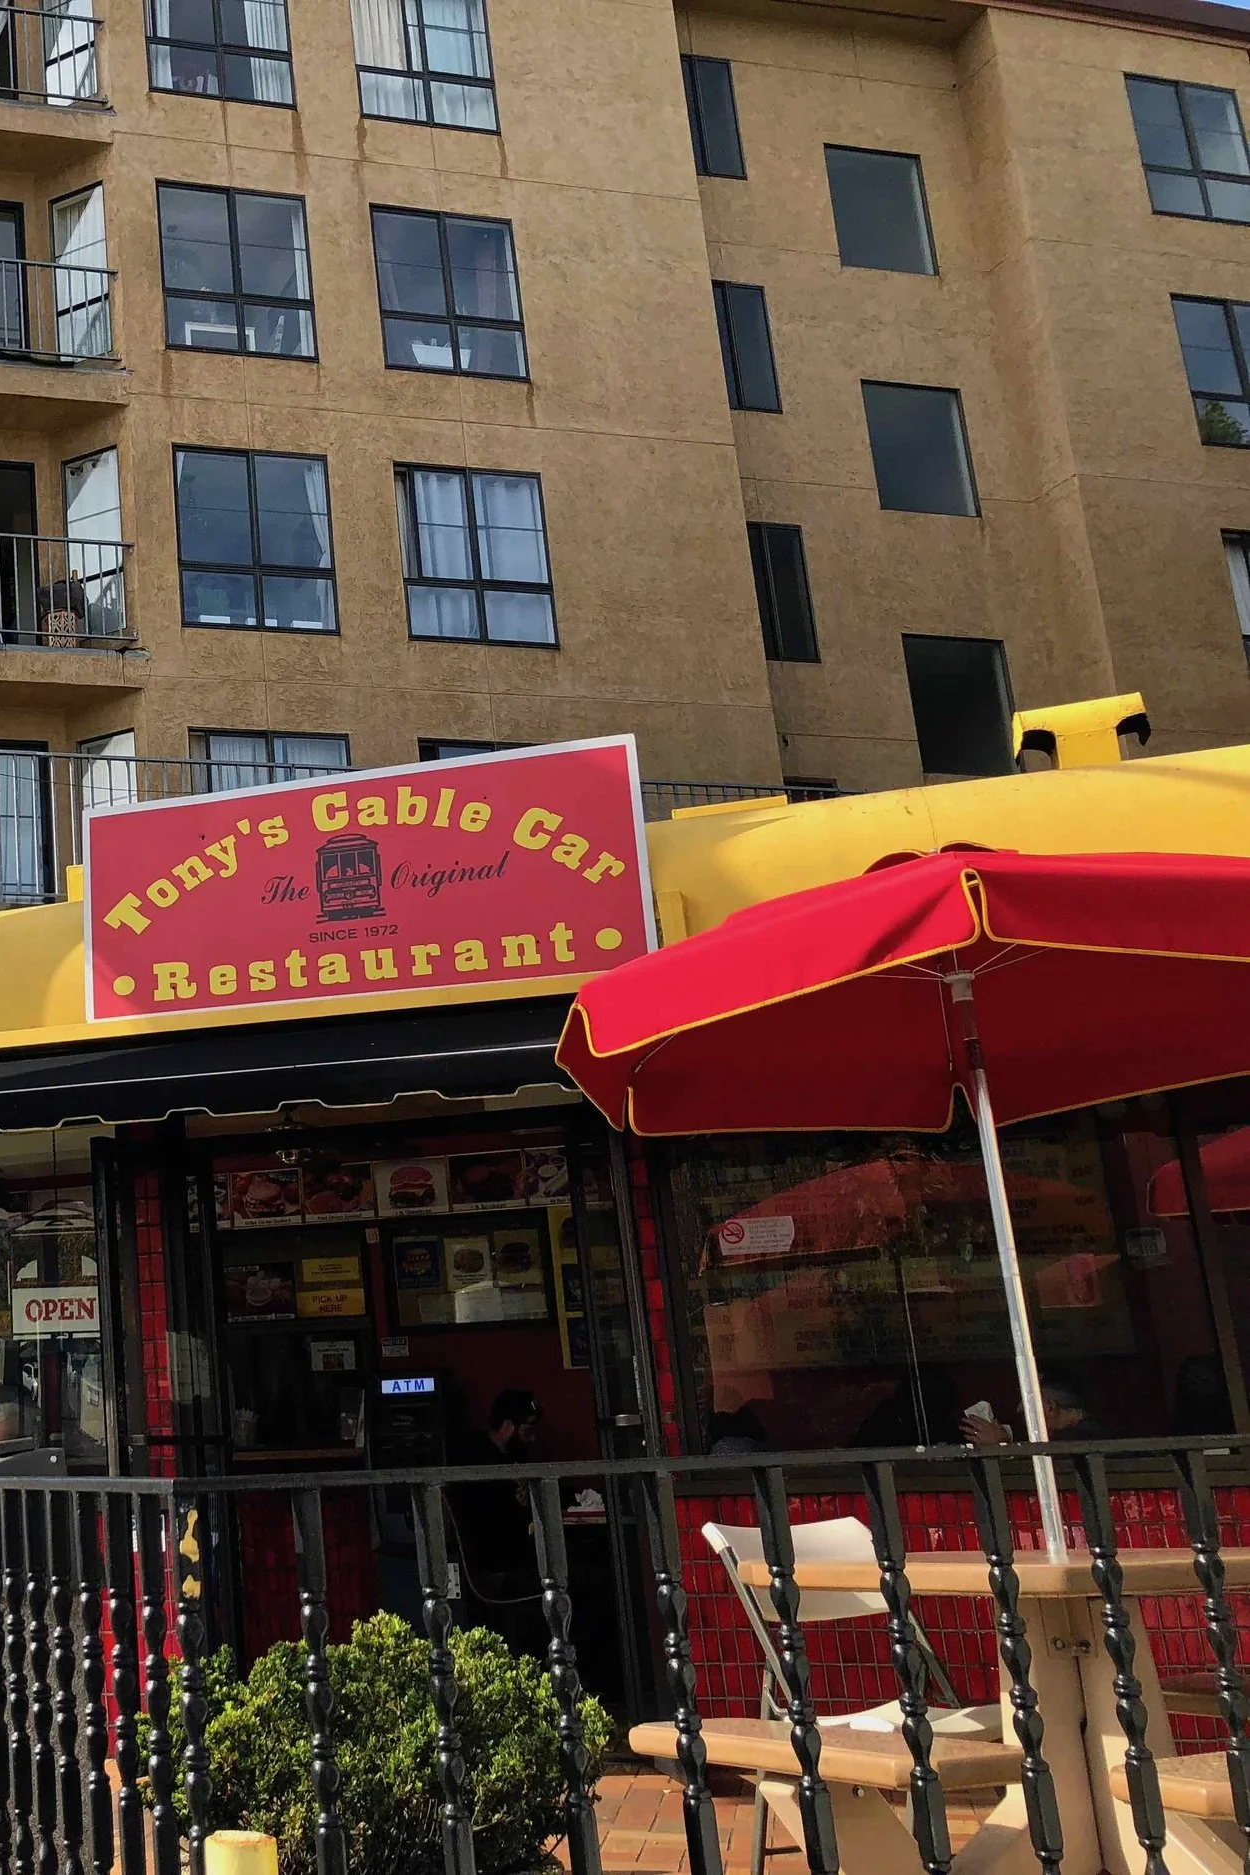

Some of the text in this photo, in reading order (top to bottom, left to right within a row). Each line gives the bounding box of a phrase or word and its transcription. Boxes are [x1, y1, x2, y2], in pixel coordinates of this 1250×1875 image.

[102, 785, 626, 936] Tony's Cable Car
[260, 875, 311, 904] The
[390, 849, 510, 898] Original
[308, 924, 399, 943] SINCE 1972
[152, 920, 577, 1003] Restaurant
[25, 1297, 97, 1322] OPEN
[392, 1380, 425, 1392] ATM
